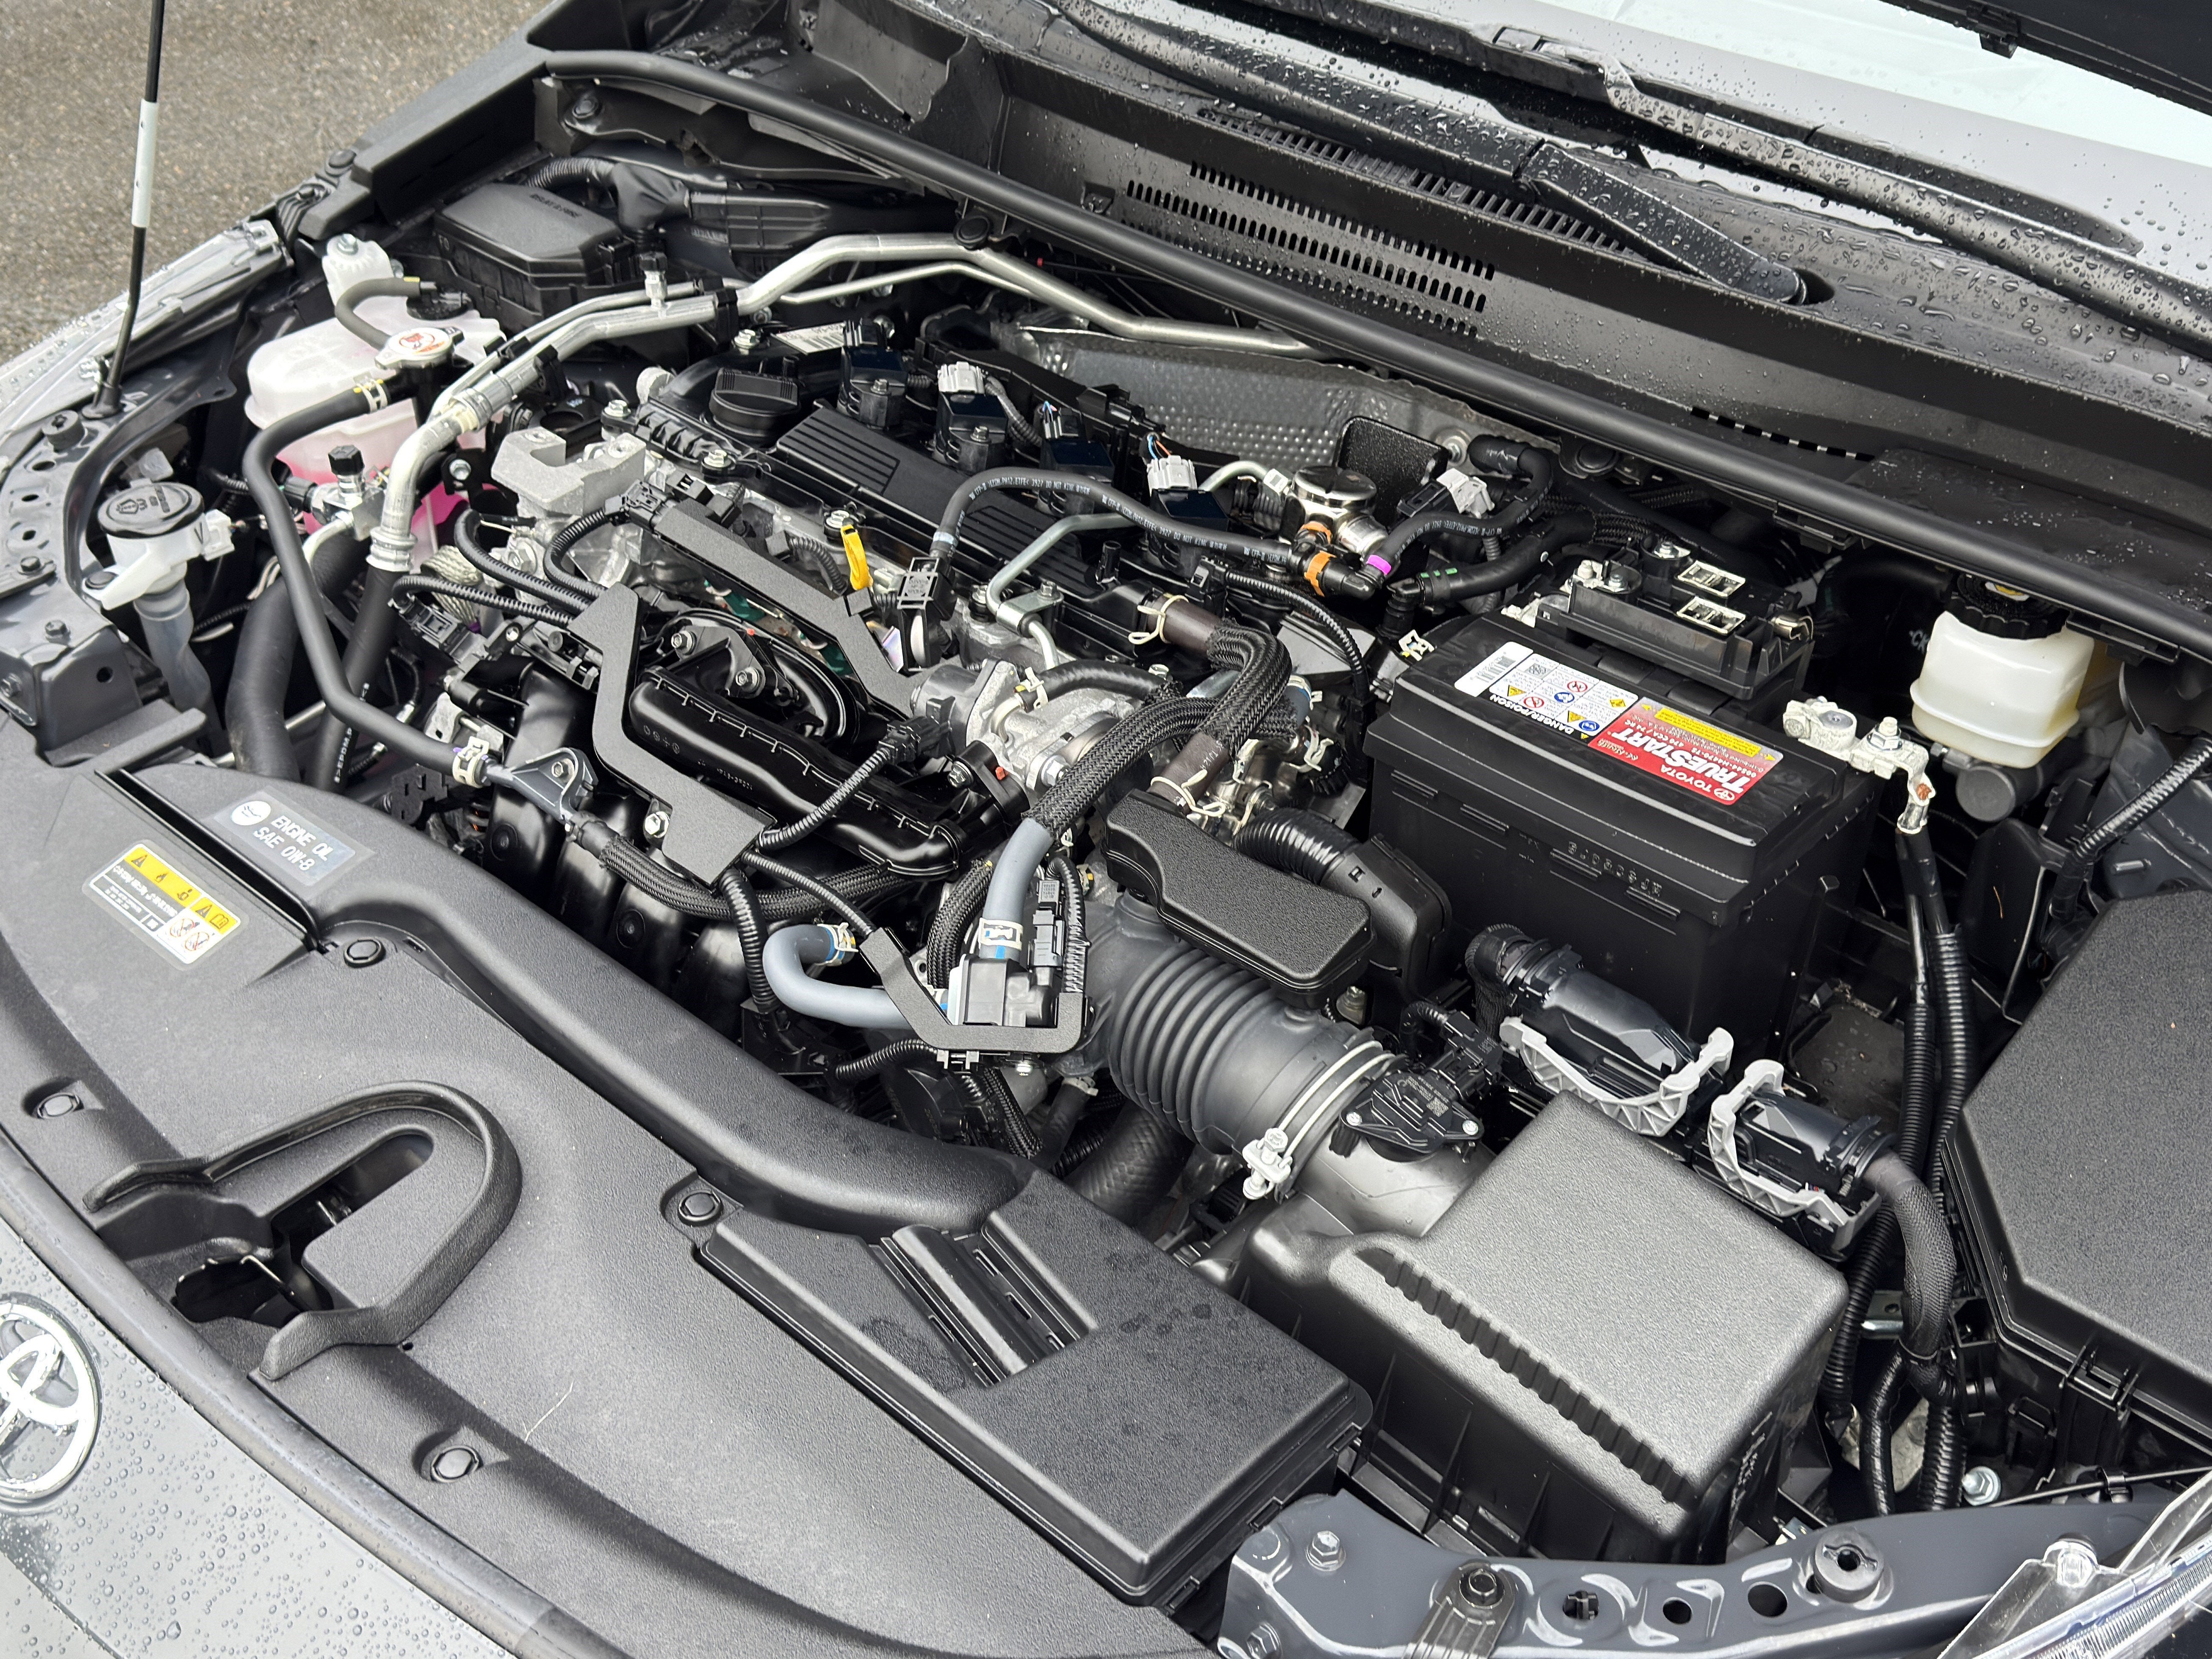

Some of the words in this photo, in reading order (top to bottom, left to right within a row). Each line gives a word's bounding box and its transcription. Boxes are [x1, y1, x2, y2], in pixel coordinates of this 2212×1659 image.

[1174, 532, 1181, 540] DO
[1182, 535, 1192, 544] NOT
[1490, 694, 1573, 734] DANGER/POISON
[1625, 719, 1636, 728] RC
[1653, 731, 1669, 741] CCA
[1670, 738, 1684, 747] 470
[1661, 765, 1712, 792] TOYOTA
[271, 816, 316, 846] ENGINE
[313, 843, 333, 861] OIL
[254, 827, 285, 849] SAE
[281, 846, 315, 870] 0W-8
